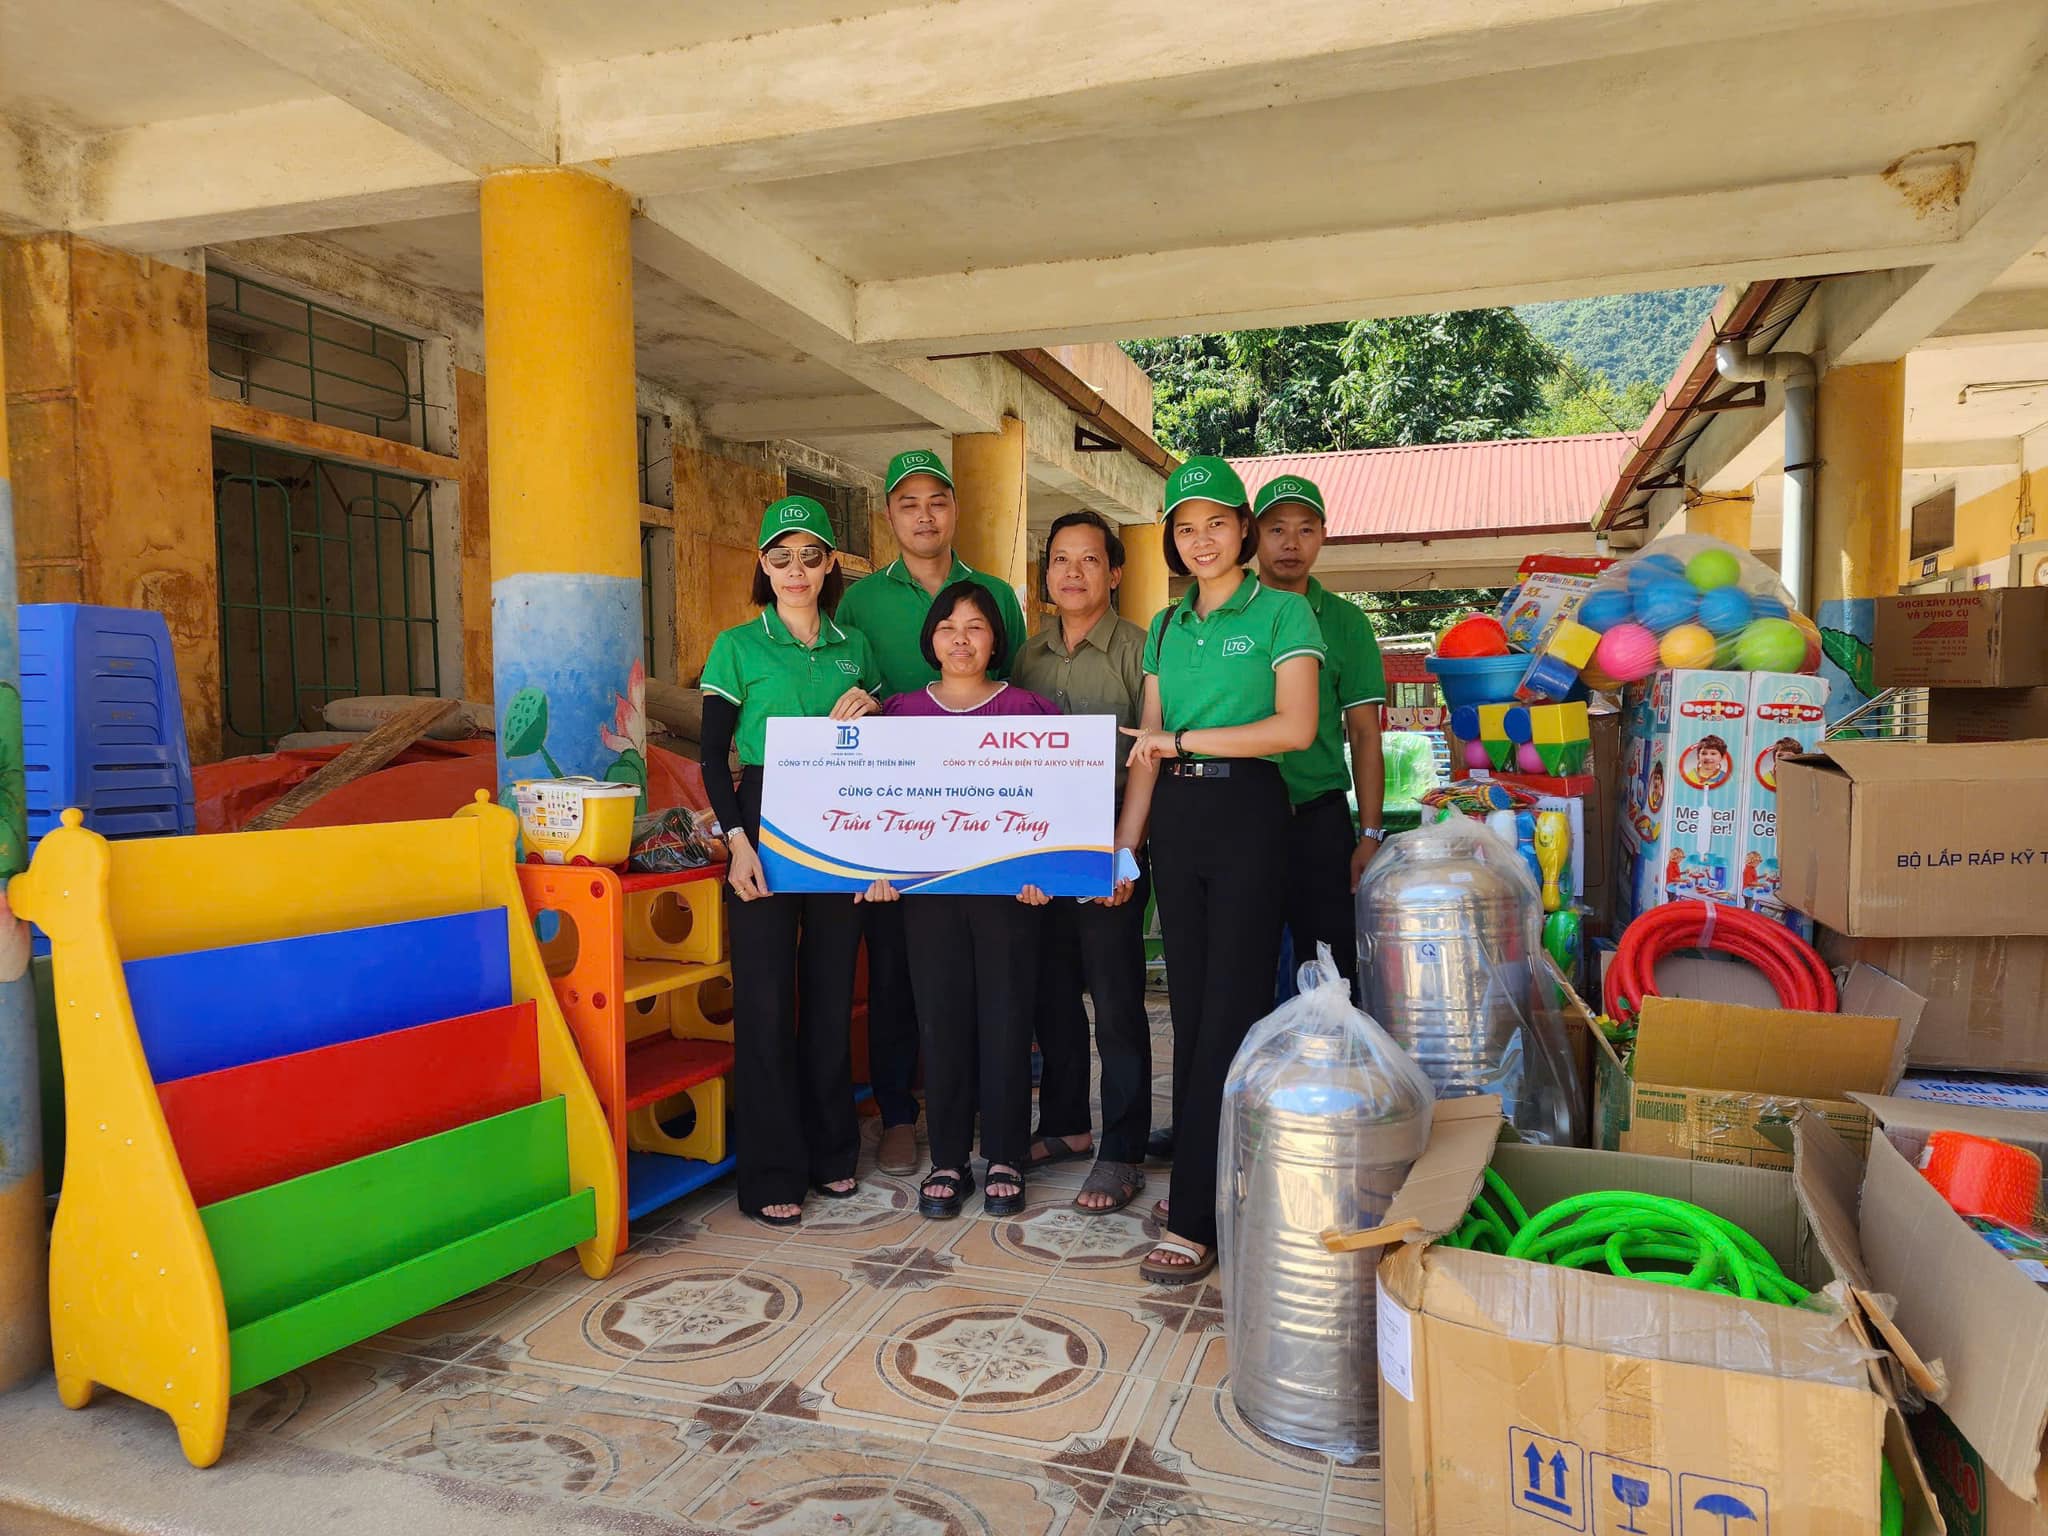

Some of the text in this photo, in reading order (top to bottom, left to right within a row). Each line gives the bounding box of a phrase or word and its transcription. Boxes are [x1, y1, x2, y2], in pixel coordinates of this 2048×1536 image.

[906, 456, 925, 464] LTG
[1183, 472, 1204, 484] LTG
[1277, 483, 1297, 492] LTG
[784, 508, 804, 518] LTG
[1226, 641, 1247, 651] LTG
[841, 662, 857, 673] LTG
[1682, 701, 1743, 714] Doctor
[1759, 704, 1821, 719] Doctor
[979, 732, 1069, 749] AIKYO
[777, 758, 801, 767] CÔNG
[942, 757, 966, 767] CÔNG
[1044, 759, 1068, 767] AIKYO
[1086, 759, 1105, 767] NAM
[838, 784, 1033, 799] CÙNG CÁC MẠNH THƯỜNG QUÂN
[822, 809, 1049, 841] Trân Trọng Trao Tặng
[1676, 820, 1732, 834] Ceer!
[1897, 851, 1921, 870] BỘ
[1968, 849, 2005, 866] RÁP
[2010, 848, 2035, 865] KỸ
